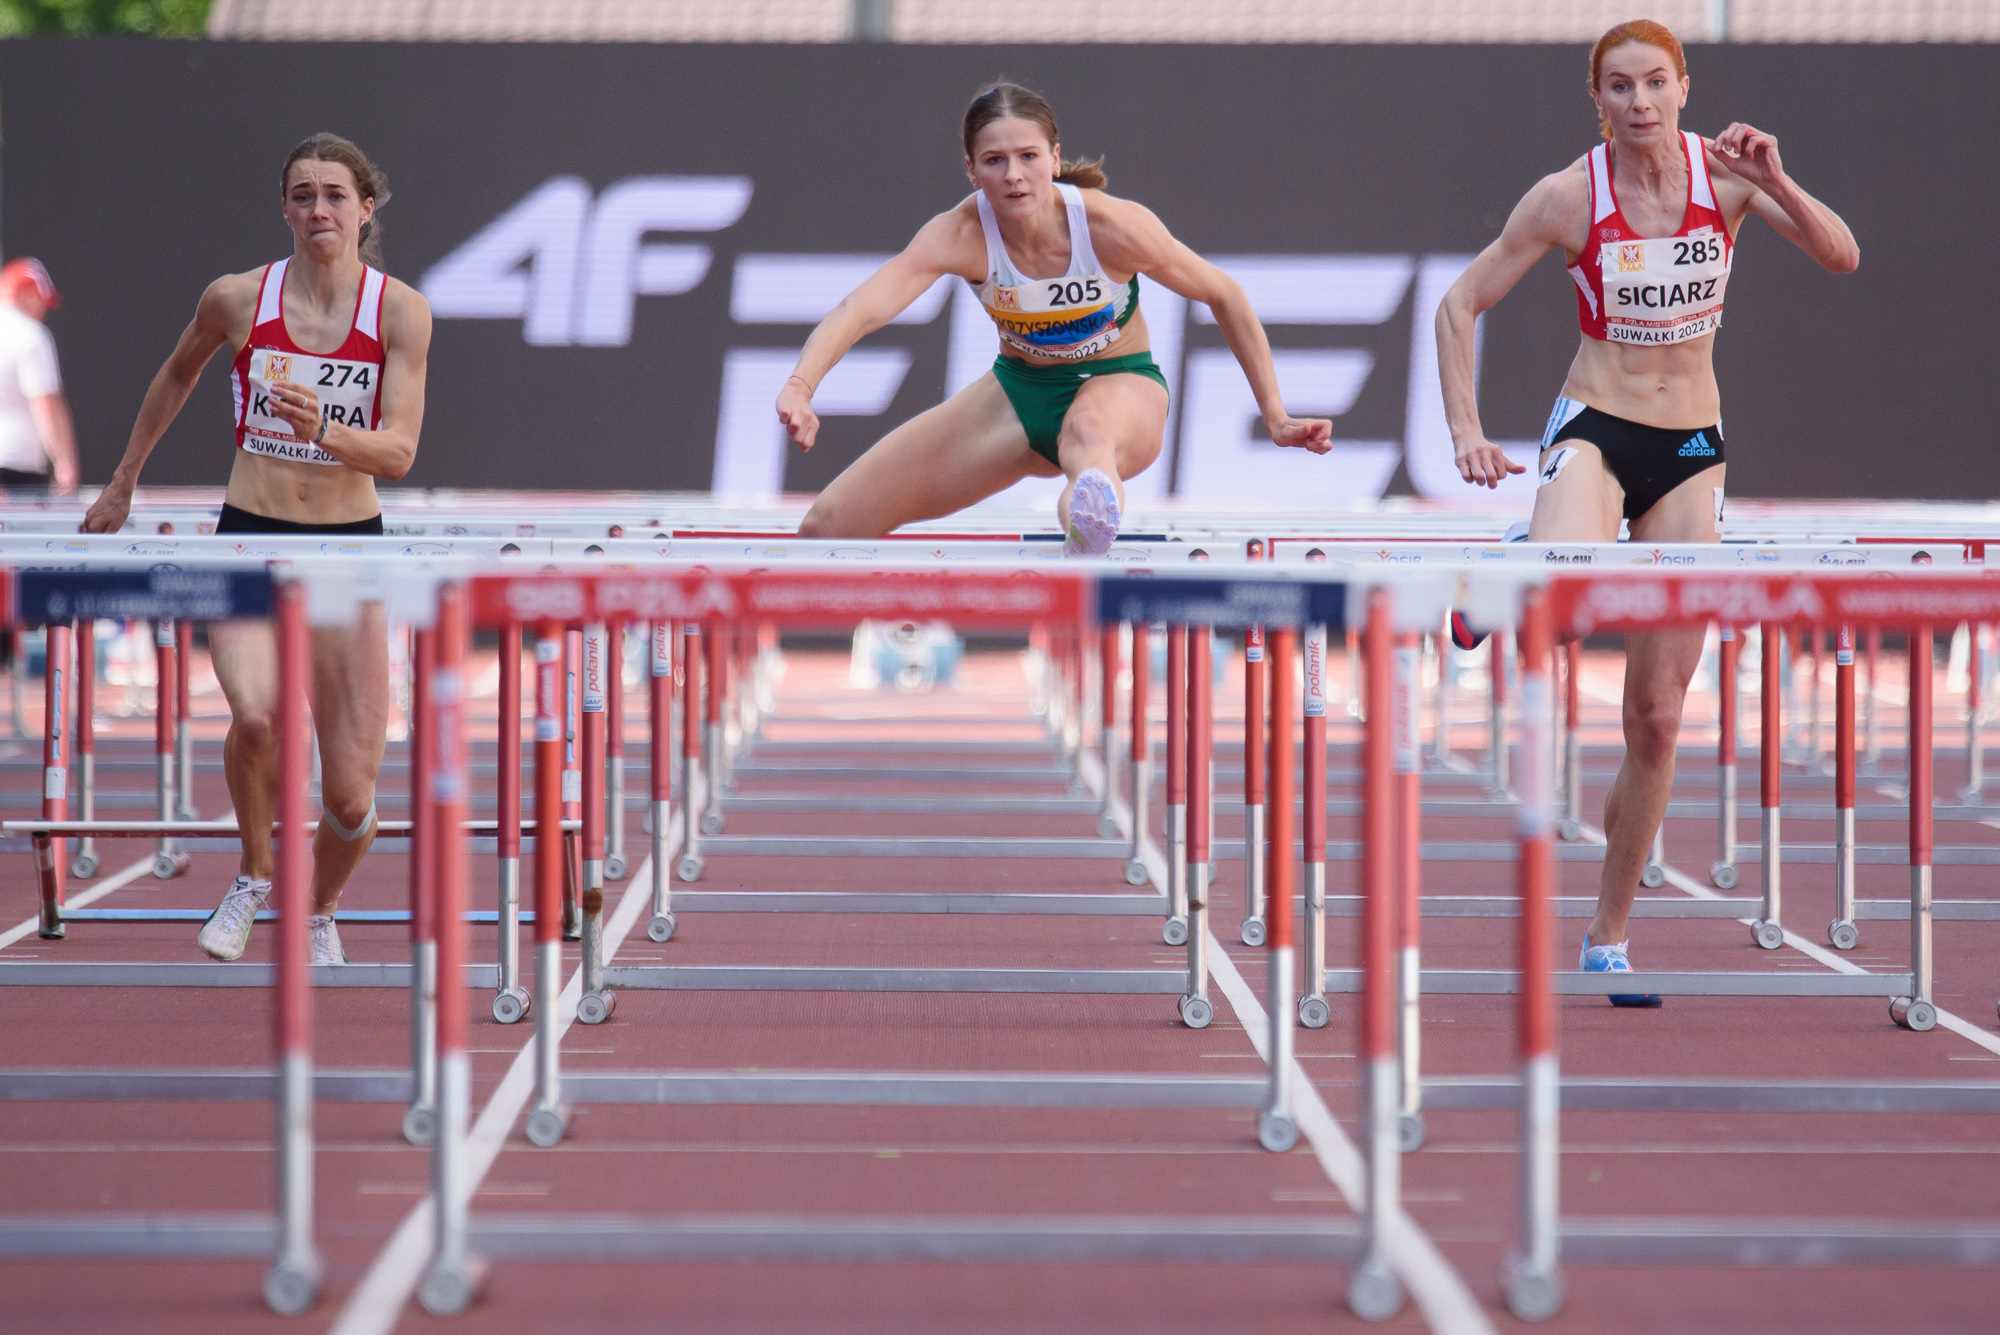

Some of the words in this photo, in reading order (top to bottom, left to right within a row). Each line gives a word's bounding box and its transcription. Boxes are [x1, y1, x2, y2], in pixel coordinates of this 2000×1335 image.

[418, 173, 755, 347] 4F
[1673, 238, 1720, 266] 285
[1619, 262, 1644, 271] PZLA
[1048, 279, 1101, 306] 205
[1617, 278, 1718, 308] SICIARZ
[1612, 327, 1674, 342] SUWAŁKI
[1678, 320, 1706, 339] 2022
[317, 363, 370, 390] 274
[250, 438, 309, 459] SUWAŁKI
[312, 449, 340, 462] 202
[1678, 447, 1716, 457] adidas
[1543, 450, 1567, 481] 4
[586, 636, 601, 693] polanik
[1308, 640, 1322, 697] polanik
